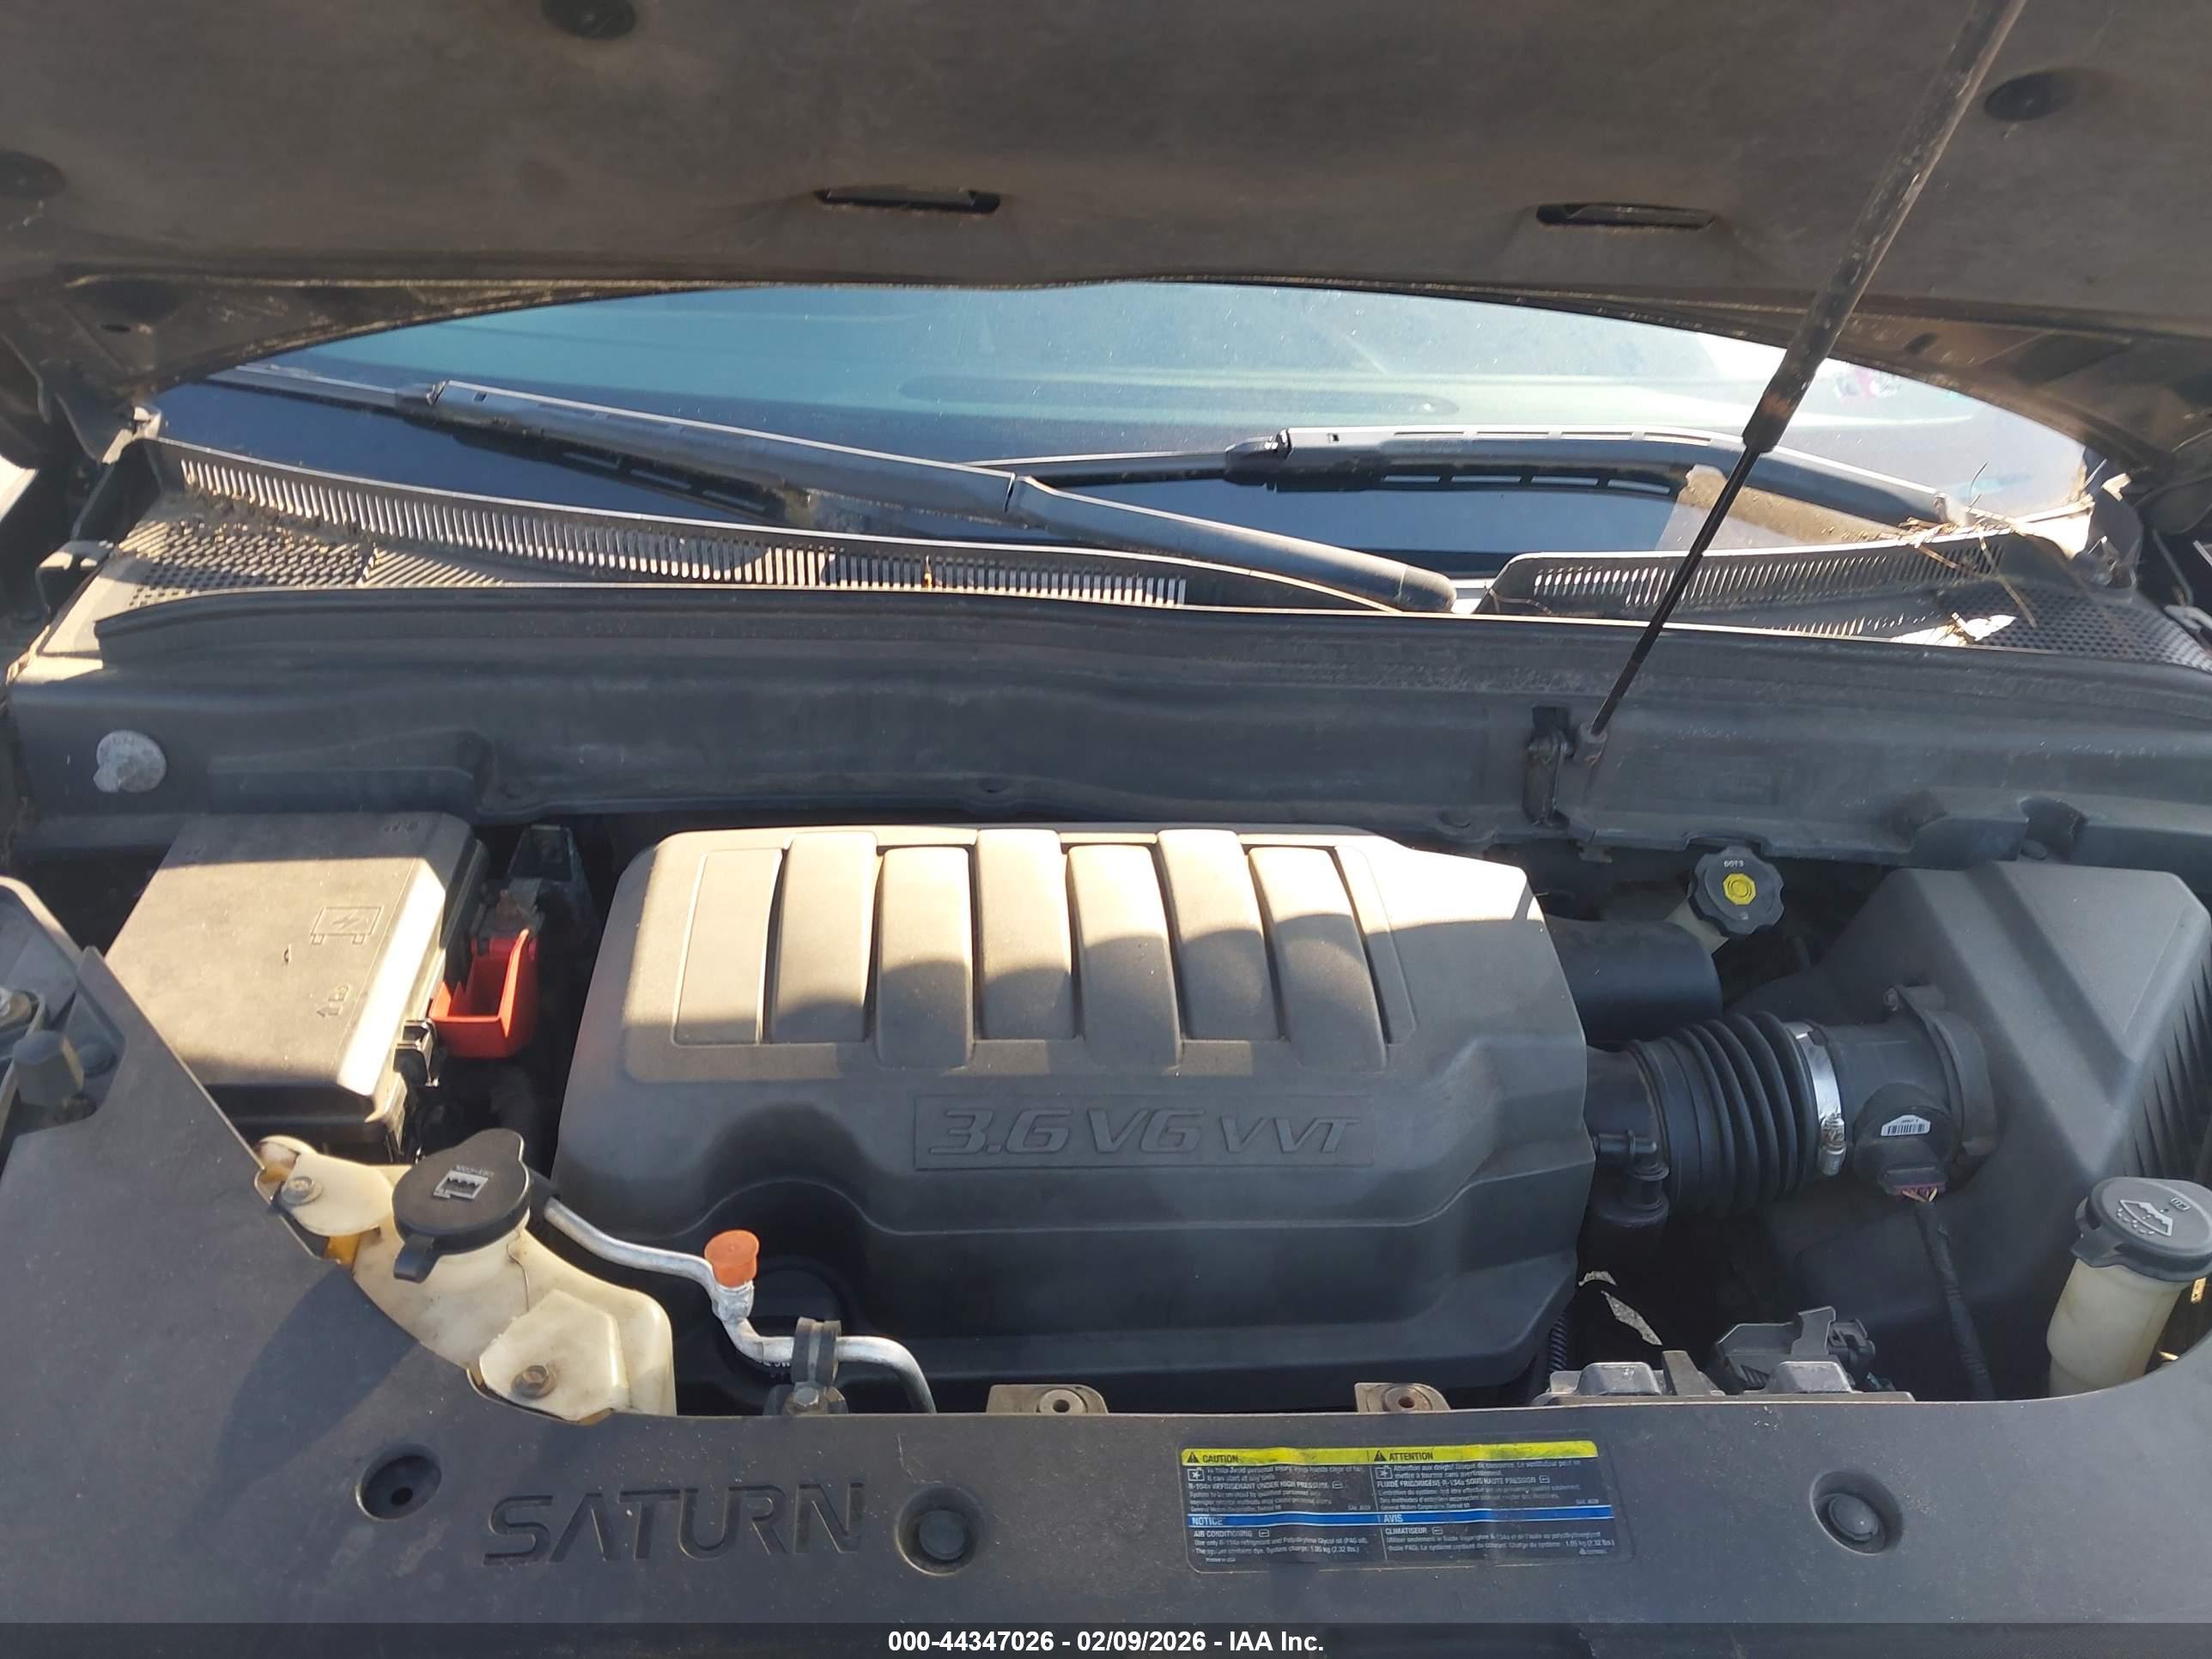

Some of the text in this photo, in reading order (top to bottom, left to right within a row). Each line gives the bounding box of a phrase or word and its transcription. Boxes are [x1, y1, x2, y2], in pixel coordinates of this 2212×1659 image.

[928, 1108, 1360, 1154] 3.6 V6 VVT
[1203, 1455, 1238, 1463] CAUTION
[1389, 1451, 1433, 1461] ATTENTION
[1192, 1516, 1224, 1526] NOTICE
[1384, 1514, 1404, 1522] AVIS
[483, 1482, 865, 1567] SATURN
